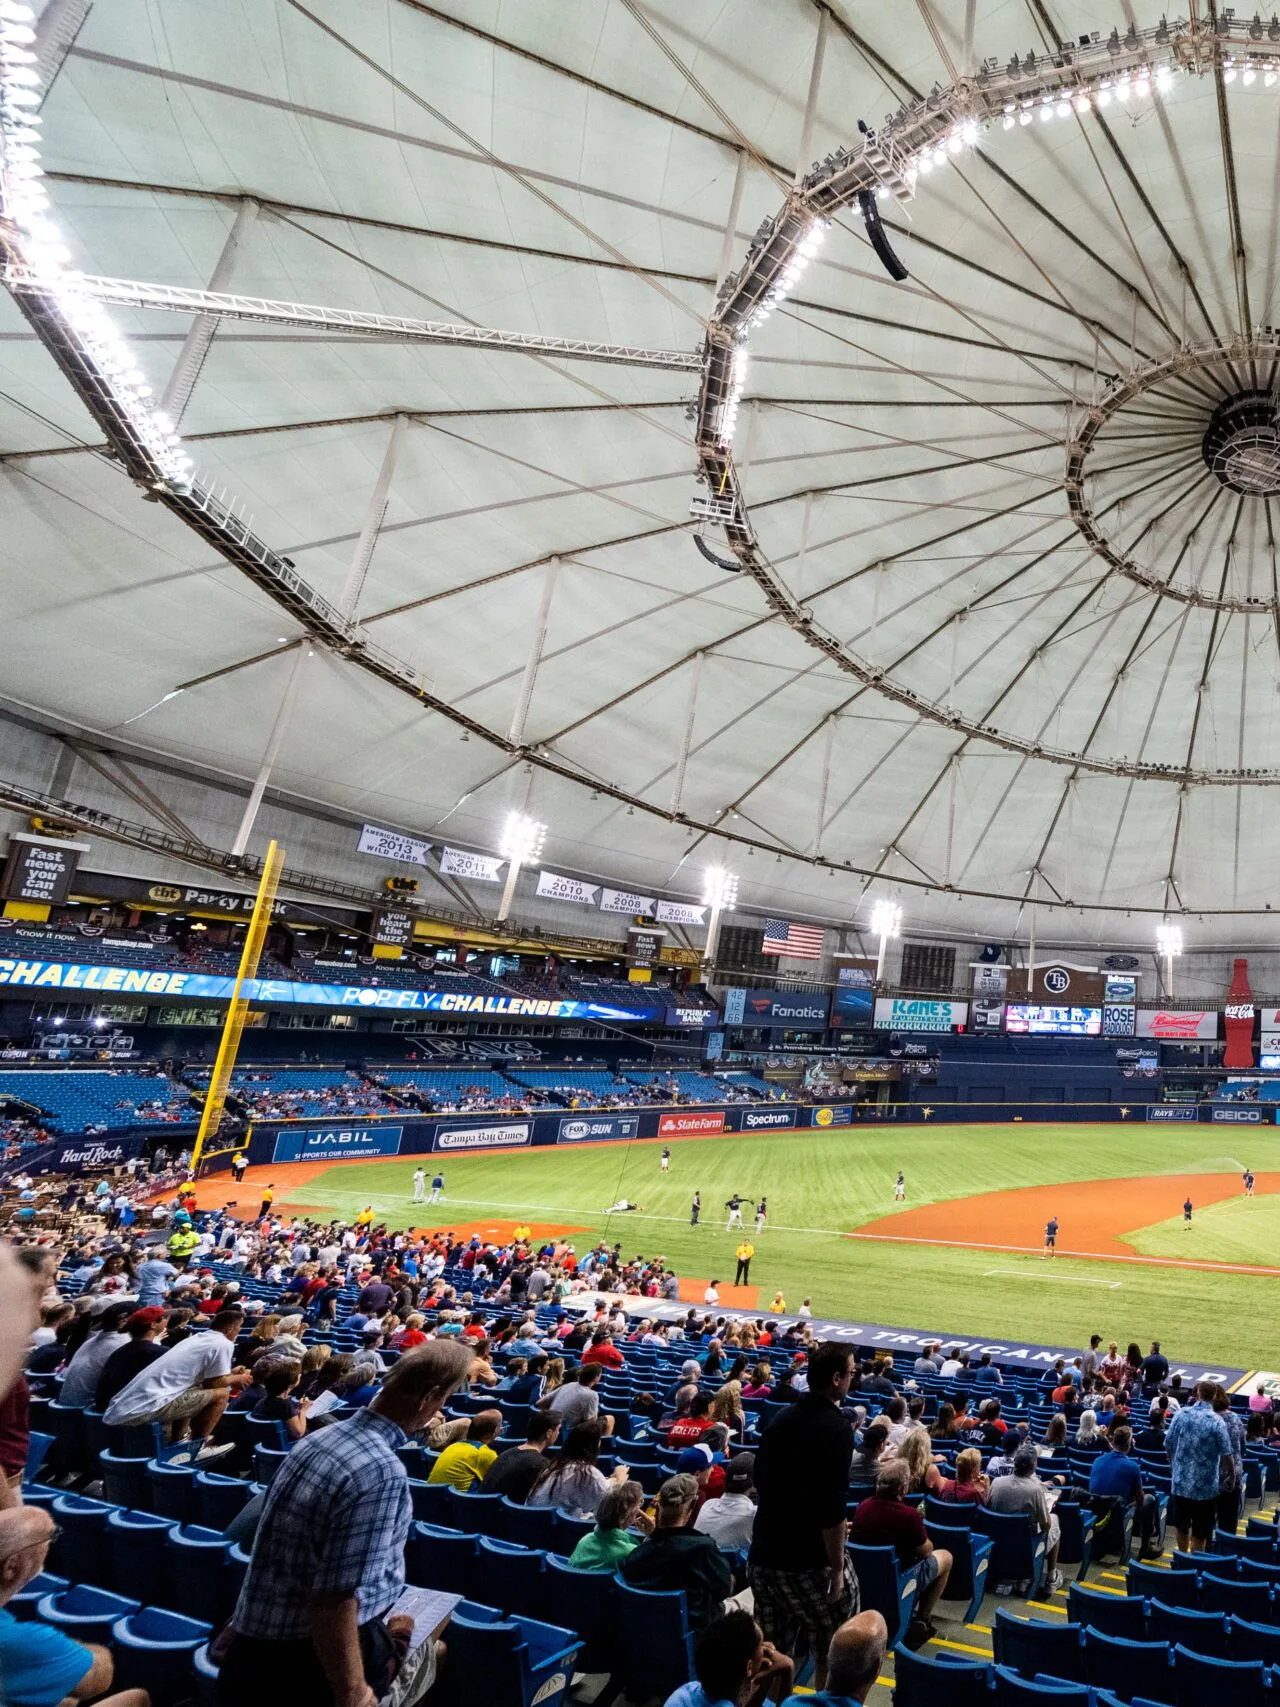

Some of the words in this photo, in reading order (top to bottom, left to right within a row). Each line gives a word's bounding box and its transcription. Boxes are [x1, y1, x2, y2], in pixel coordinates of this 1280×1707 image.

[365, 829, 400, 842] AMERICAN
[402, 837, 427, 849] LEAGUE
[379, 838, 413, 854] 2013
[30, 847, 63, 862] Fast
[366, 844, 391, 856] WILD
[393, 851, 418, 862] CARD
[25, 858, 66, 872] news
[457, 858, 486, 872] 2011
[28, 868, 57, 881] you
[446, 865, 467, 874] WILD
[470, 870, 491, 879] CARD
[26, 879, 54, 890] can
[552, 882, 583, 895] 2010
[21, 888, 52, 900] use.
[154, 887, 177, 900] tbt
[185, 889, 240, 911] Party
[541, 888, 589, 903] CHAMPIONS
[604, 903, 647, 915] CHAMPIONS
[613, 897, 641, 909] 2008
[387, 912, 407, 921] you
[668, 908, 693, 917] 2008
[379, 918, 411, 929] heard
[660, 915, 699, 924] CHAMPIONS
[15, 928, 44, 939] Know
[54, 933, 77, 942] now.
[377, 932, 408, 943] buzz?
[384, 926, 403, 936] the
[102, 938, 154, 949] tampabay.com
[637, 935, 654, 943] Fast
[314, 959, 357, 969] tampabay.com
[375, 965, 395, 973] Know
[0, 959, 189, 994] CHALLENGE
[1051, 972, 1066, 989] TB
[731, 990, 743, 1000] 42
[396, 990, 437, 1009] FLY
[440, 994, 562, 1016] CHALLENGE
[730, 1002, 741, 1011] 12
[892, 1000, 952, 1016] KANE'S
[676, 1008, 711, 1017] REPUBLIC
[727, 1013, 740, 1022] 66
[771, 1004, 825, 1019] Fanatics
[1104, 1008, 1134, 1022] ROSE
[682, 1015, 704, 1023] BANK
[1103, 1022, 1133, 1035] RADIOLOGY
[746, 1112, 789, 1126] Spectrum
[1214, 1111, 1260, 1121] GEICO
[591, 1124, 613, 1134] SUN
[309, 1132, 374, 1145] JABIL
[443, 1133, 476, 1145] Tampa
[477, 1132, 496, 1143] Bay
[497, 1131, 525, 1141] Times
[60, 1149, 90, 1163] Hard
[90, 1145, 122, 1162] Rock
[294, 1151, 328, 1160] SUPPORTS
[328, 1150, 342, 1158] OUR
[342, 1148, 381, 1157] COMMUNITY
[816, 1324, 864, 1337] TO
